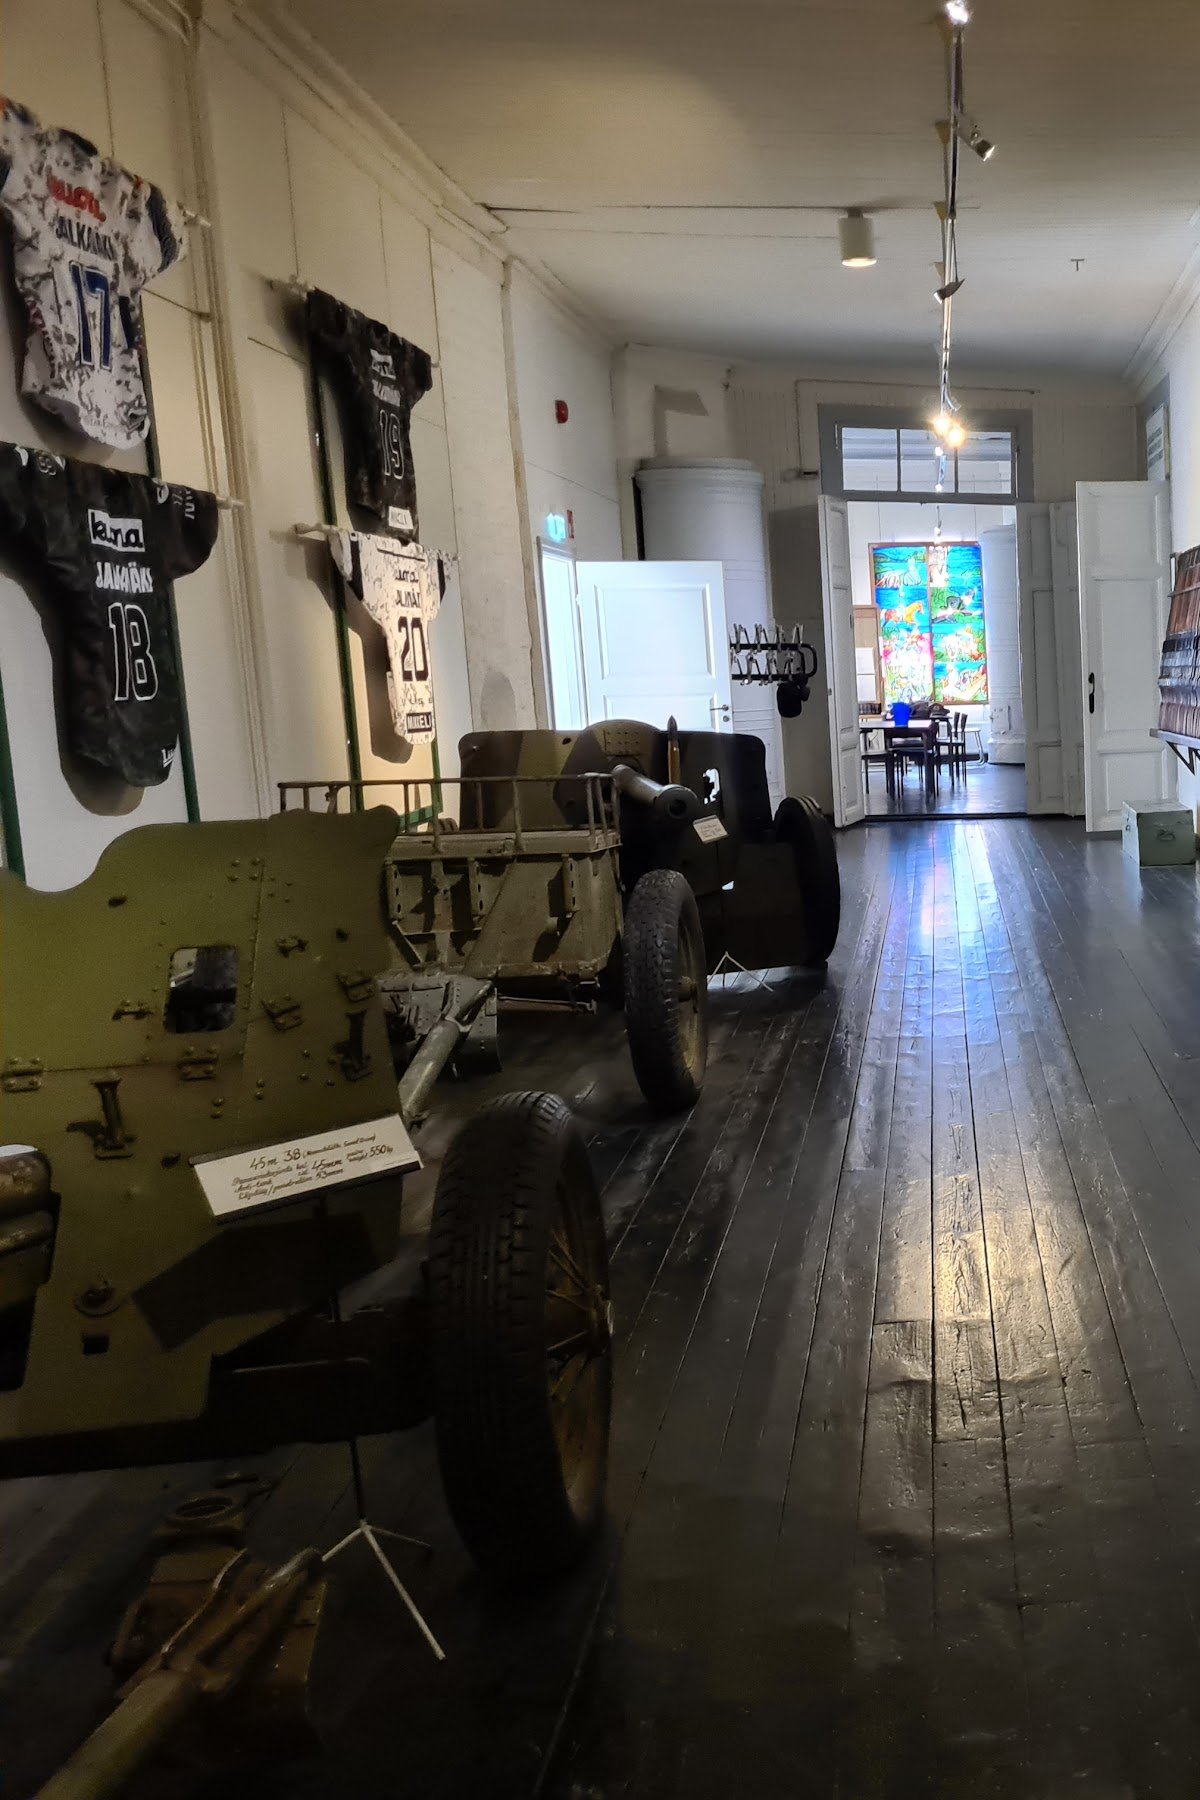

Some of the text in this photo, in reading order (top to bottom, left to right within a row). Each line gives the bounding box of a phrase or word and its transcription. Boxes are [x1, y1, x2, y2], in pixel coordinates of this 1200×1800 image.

[69, 260, 112, 372] 17
[380, 409, 404, 479] 19
[108, 602, 158, 701] 18
[398, 616, 429, 681] 20
[283, 1147, 301, 1161] 38
